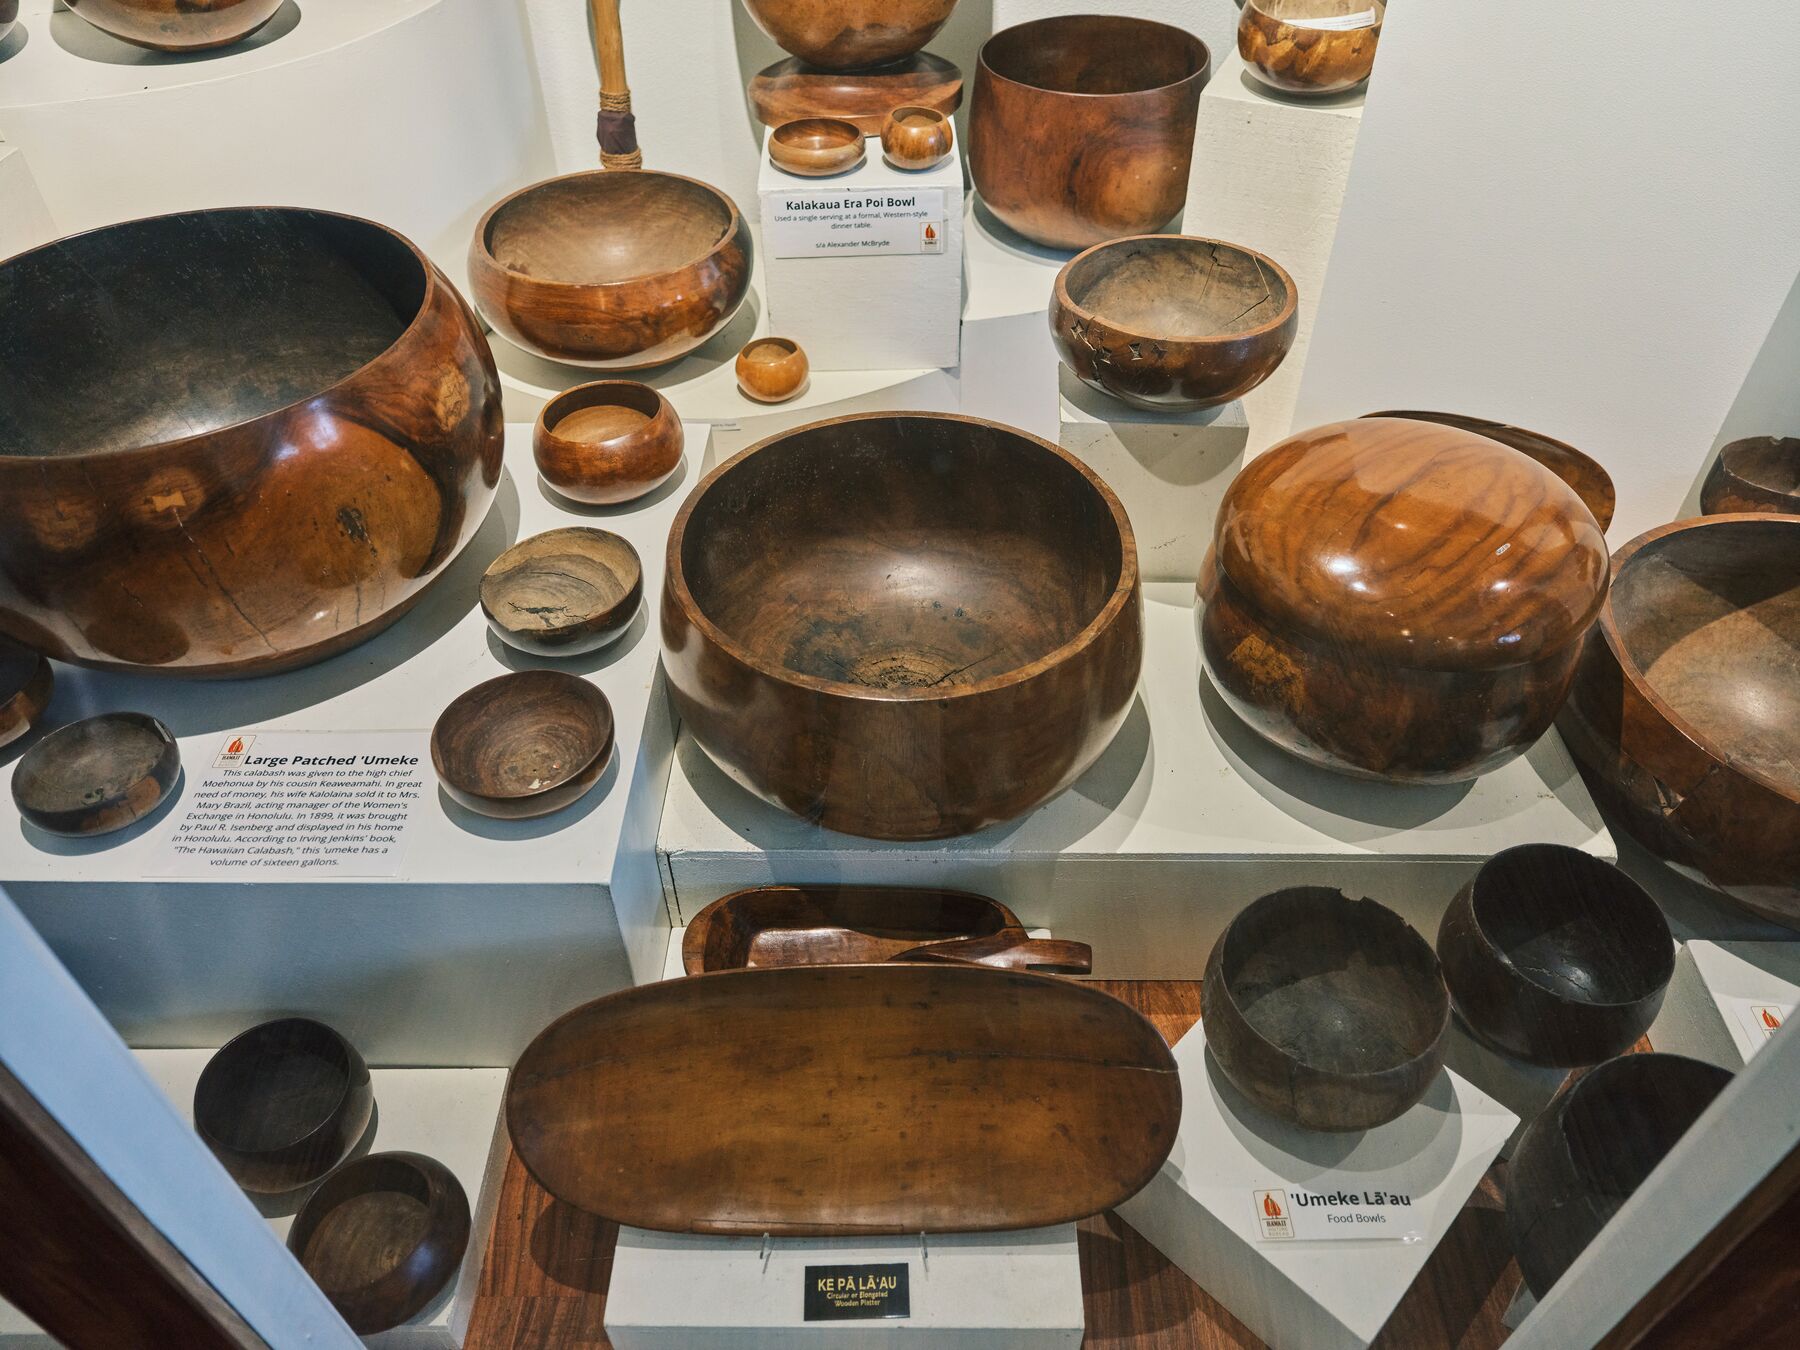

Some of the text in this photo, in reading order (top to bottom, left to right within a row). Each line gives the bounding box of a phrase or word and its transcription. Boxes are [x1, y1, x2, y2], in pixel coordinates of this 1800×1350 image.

[786, 197, 915, 210] Kalakaua Era Poi Bowl
[245, 756, 288, 767] Large
[292, 756, 356, 765] Patched
[361, 755, 418, 765] 'Umeke
[256, 780, 268, 789] by
[196, 802, 221, 810] Mary
[224, 802, 252, 810] Brazil,
[255, 802, 284, 810] acting
[186, 813, 233, 821] Exchange
[368, 812, 407, 821] brought
[180, 824, 192, 832] by
[230, 824, 273, 832] Isenberg
[297, 824, 344, 832] displayed
[235, 835, 285, 844] According
[300, 835, 327, 844] Irving
[328, 835, 368, 844] Jenkins'
[370, 835, 396, 843] book,
[300, 859, 339, 868] gallons.
[1291, 1192, 1359, 1206] 'Umeke
[1328, 1214, 1386, 1223] Food Bowls
[818, 1279, 834, 1291] KE
[838, 1276, 856, 1290] PĀ
[860, 1291, 888, 1299] Elongated
